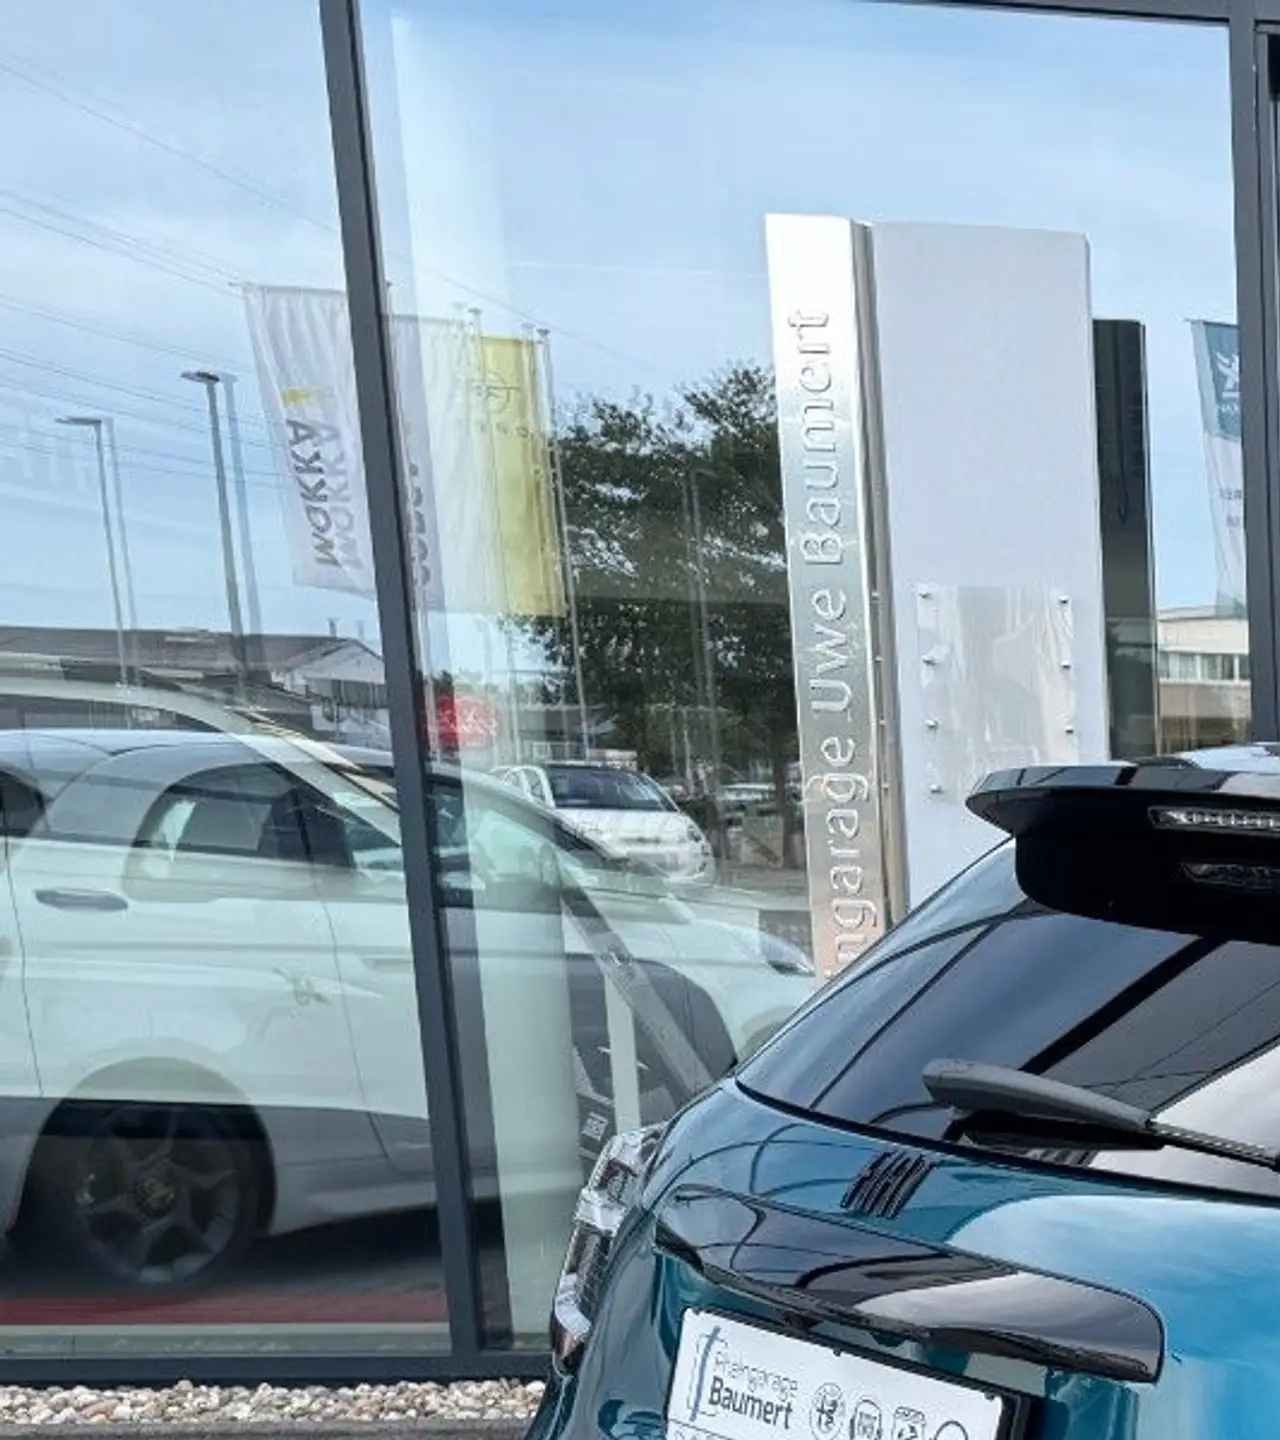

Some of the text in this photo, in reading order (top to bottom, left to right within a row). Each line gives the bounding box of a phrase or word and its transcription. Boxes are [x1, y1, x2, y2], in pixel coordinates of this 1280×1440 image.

[787, 309, 844, 566] Baumert
[810, 588, 855, 715] Uwe
[708, 1377, 792, 1429] Baumert
